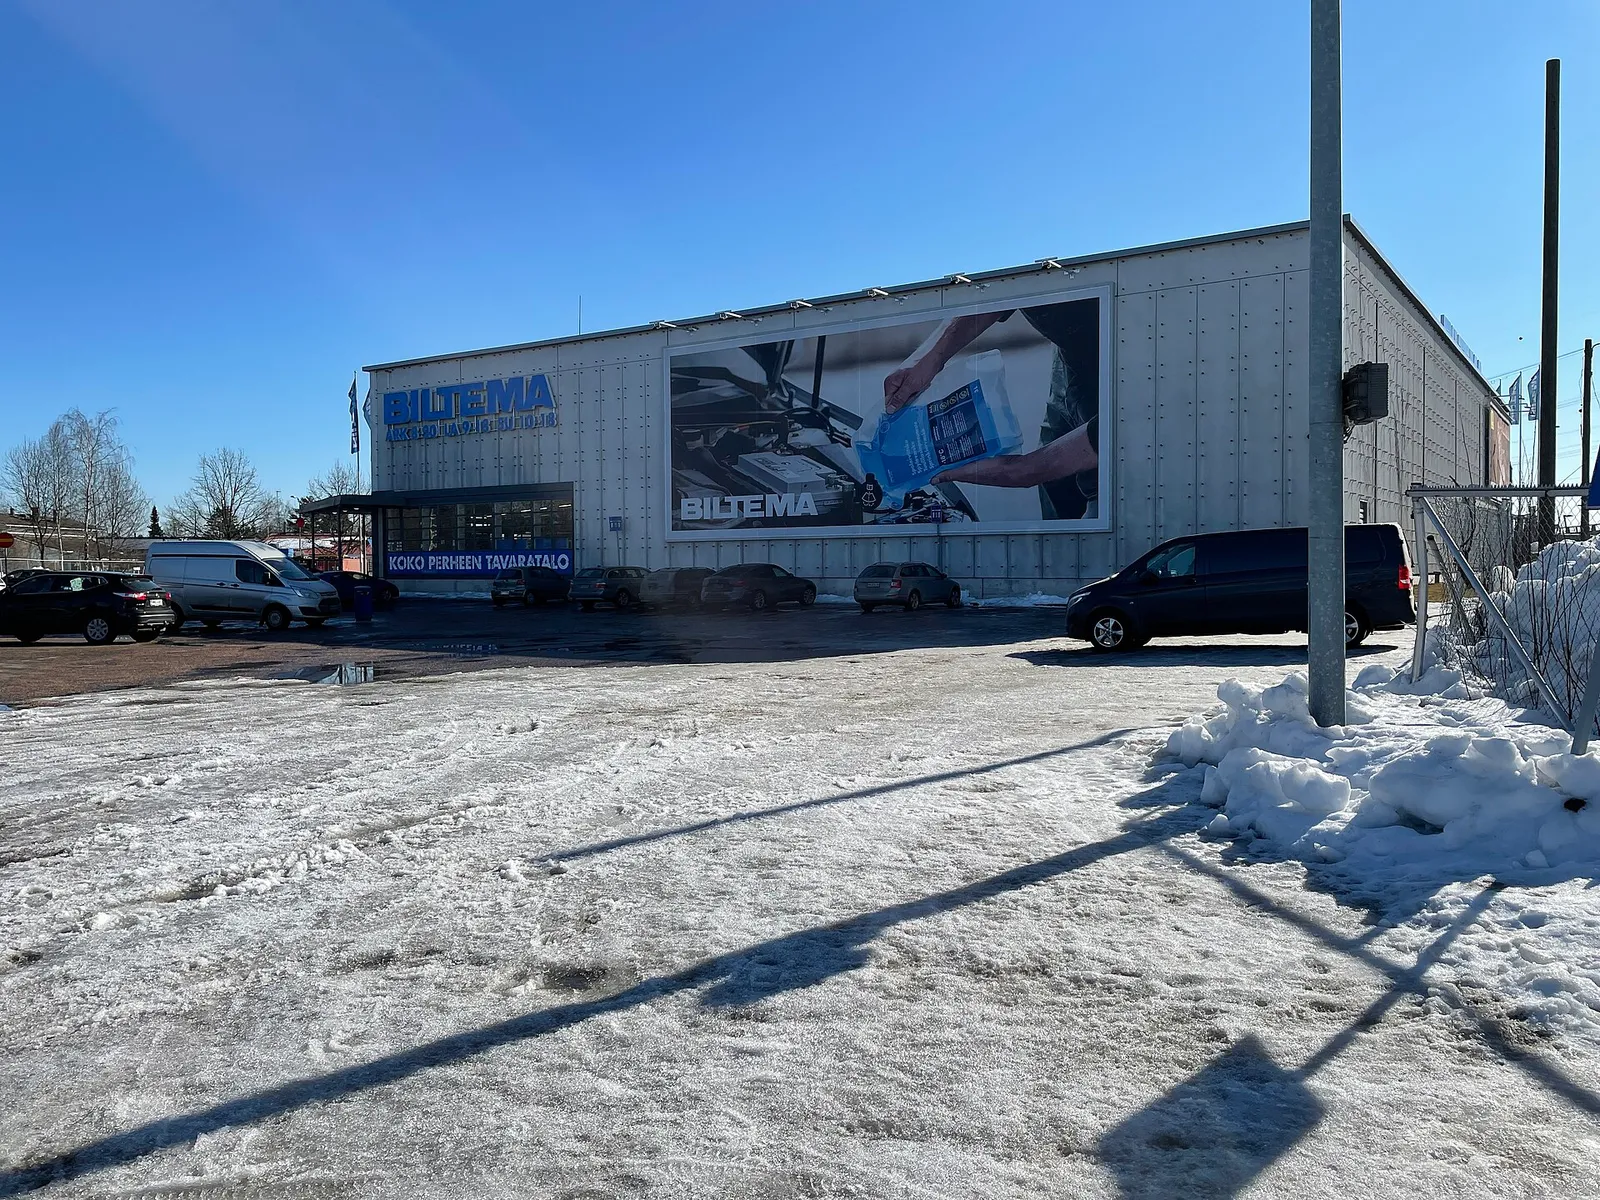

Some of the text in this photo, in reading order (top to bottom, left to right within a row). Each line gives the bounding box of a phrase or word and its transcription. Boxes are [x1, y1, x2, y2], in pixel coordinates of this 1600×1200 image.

[384, 374, 557, 425] BILTEMA
[386, 425, 410, 441] ARK
[444, 422, 460, 436] LA
[498, 416, 515, 432] SU
[681, 492, 818, 520] BILTEMA
[389, 554, 570, 570] KOKO PERHEEN TAVARATALO
